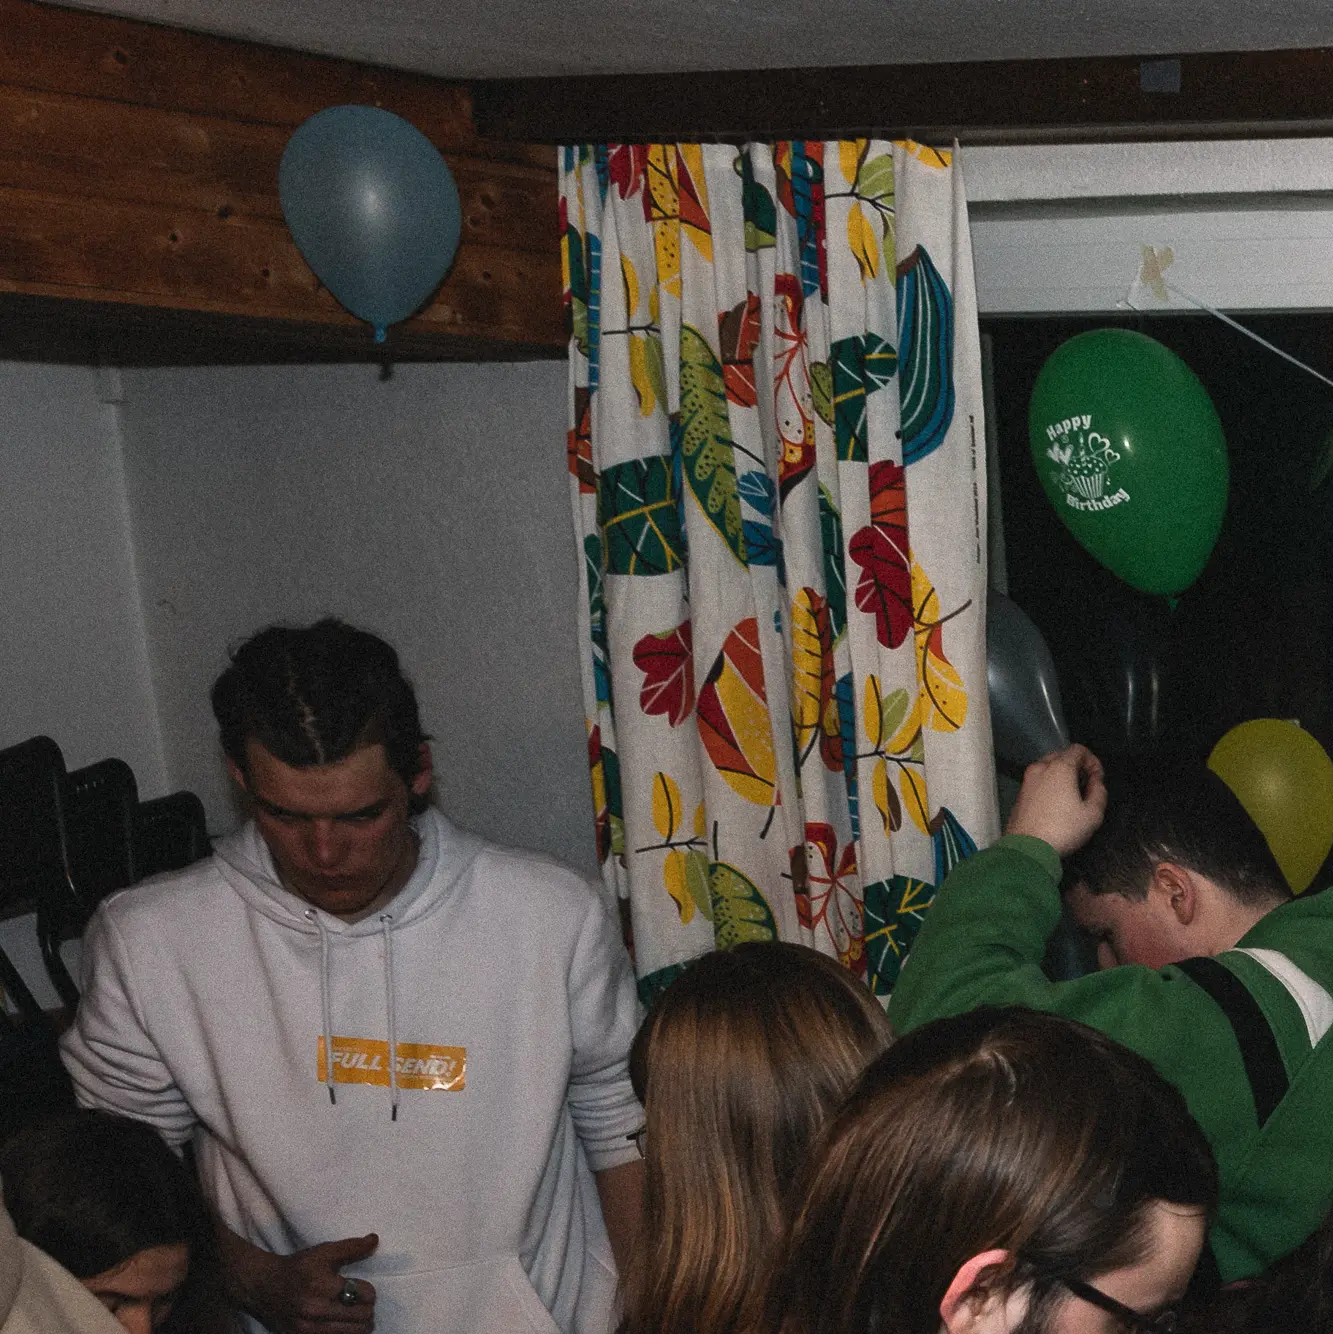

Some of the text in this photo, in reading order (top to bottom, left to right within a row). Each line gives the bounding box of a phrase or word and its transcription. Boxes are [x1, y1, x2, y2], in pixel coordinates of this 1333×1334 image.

[1047, 415, 1092, 440] Happy
[1066, 488, 1131, 510] Birthday
[331, 1051, 382, 1071] FULL
